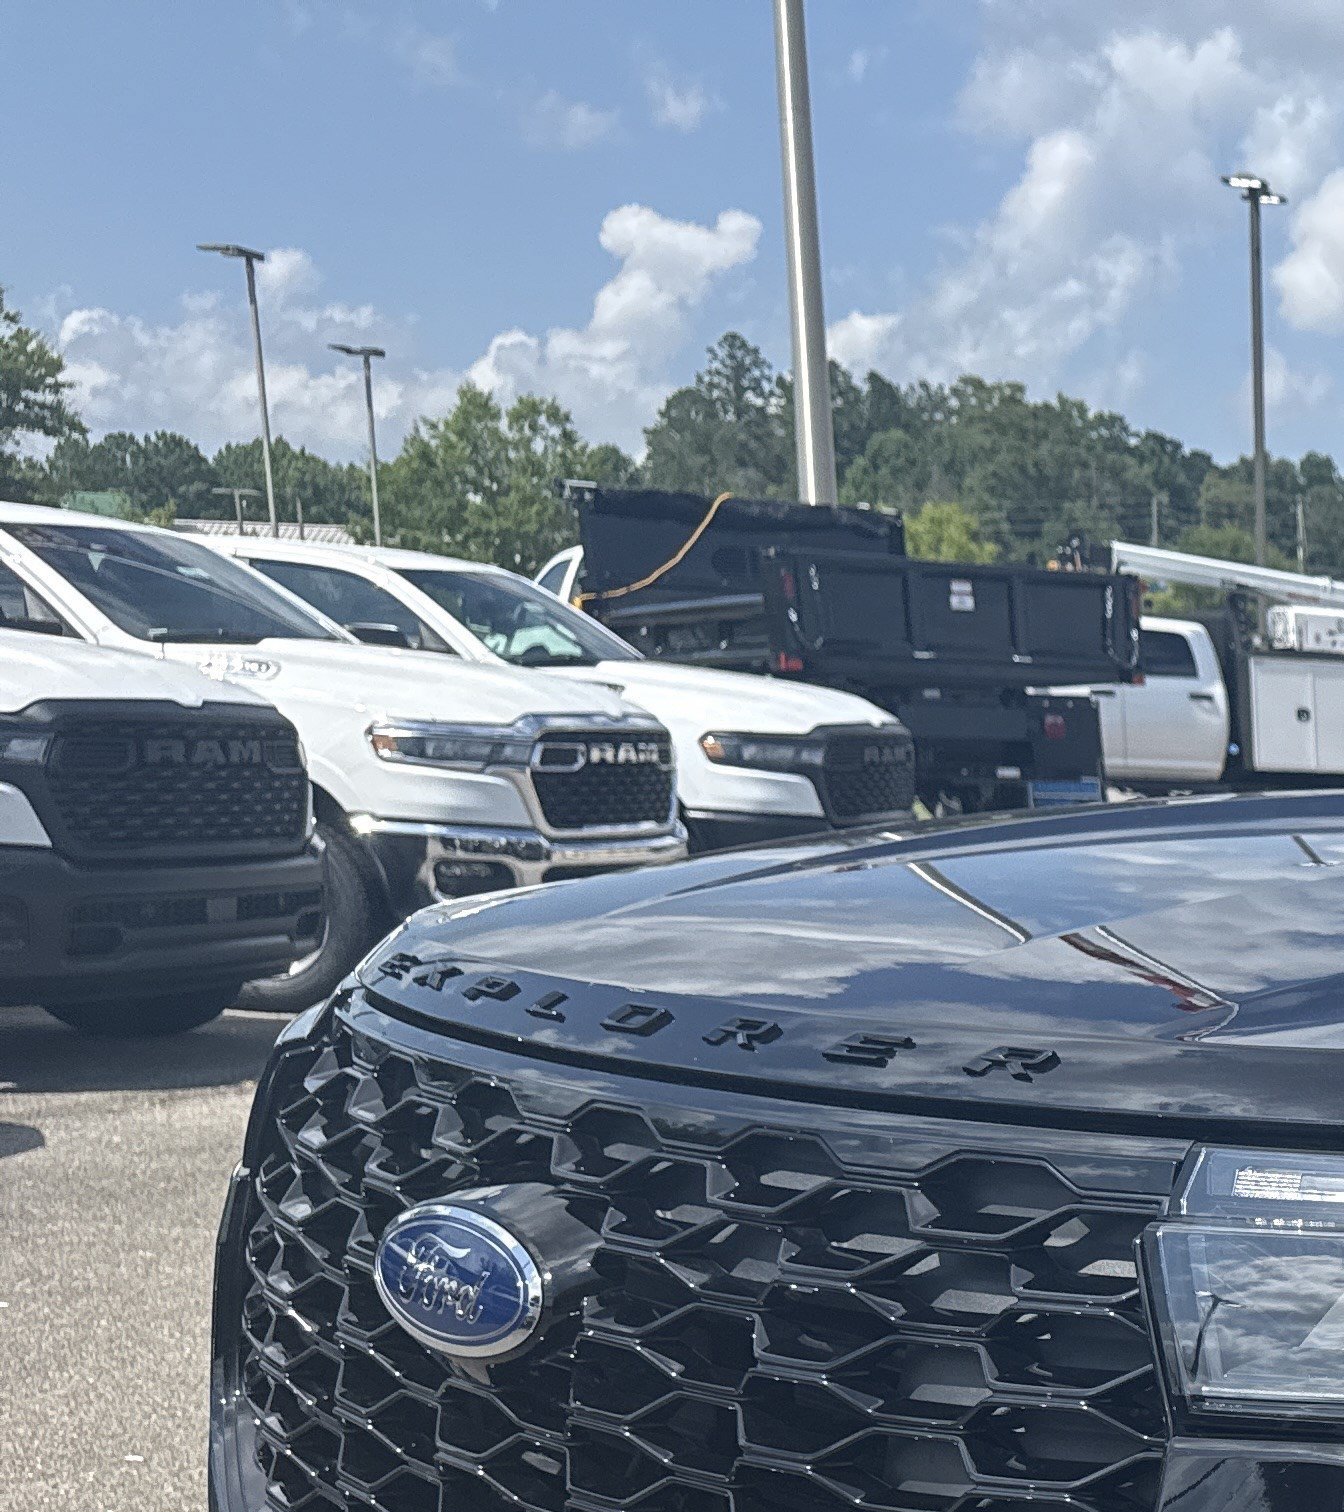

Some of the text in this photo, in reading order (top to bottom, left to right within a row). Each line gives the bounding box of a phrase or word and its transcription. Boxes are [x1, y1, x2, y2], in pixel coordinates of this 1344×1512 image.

[144, 738, 262, 764] RAM
[589, 741, 659, 764] RAM
[377, 953, 1062, 1083] EXPLORER
[397, 1233, 491, 1325] Ford
